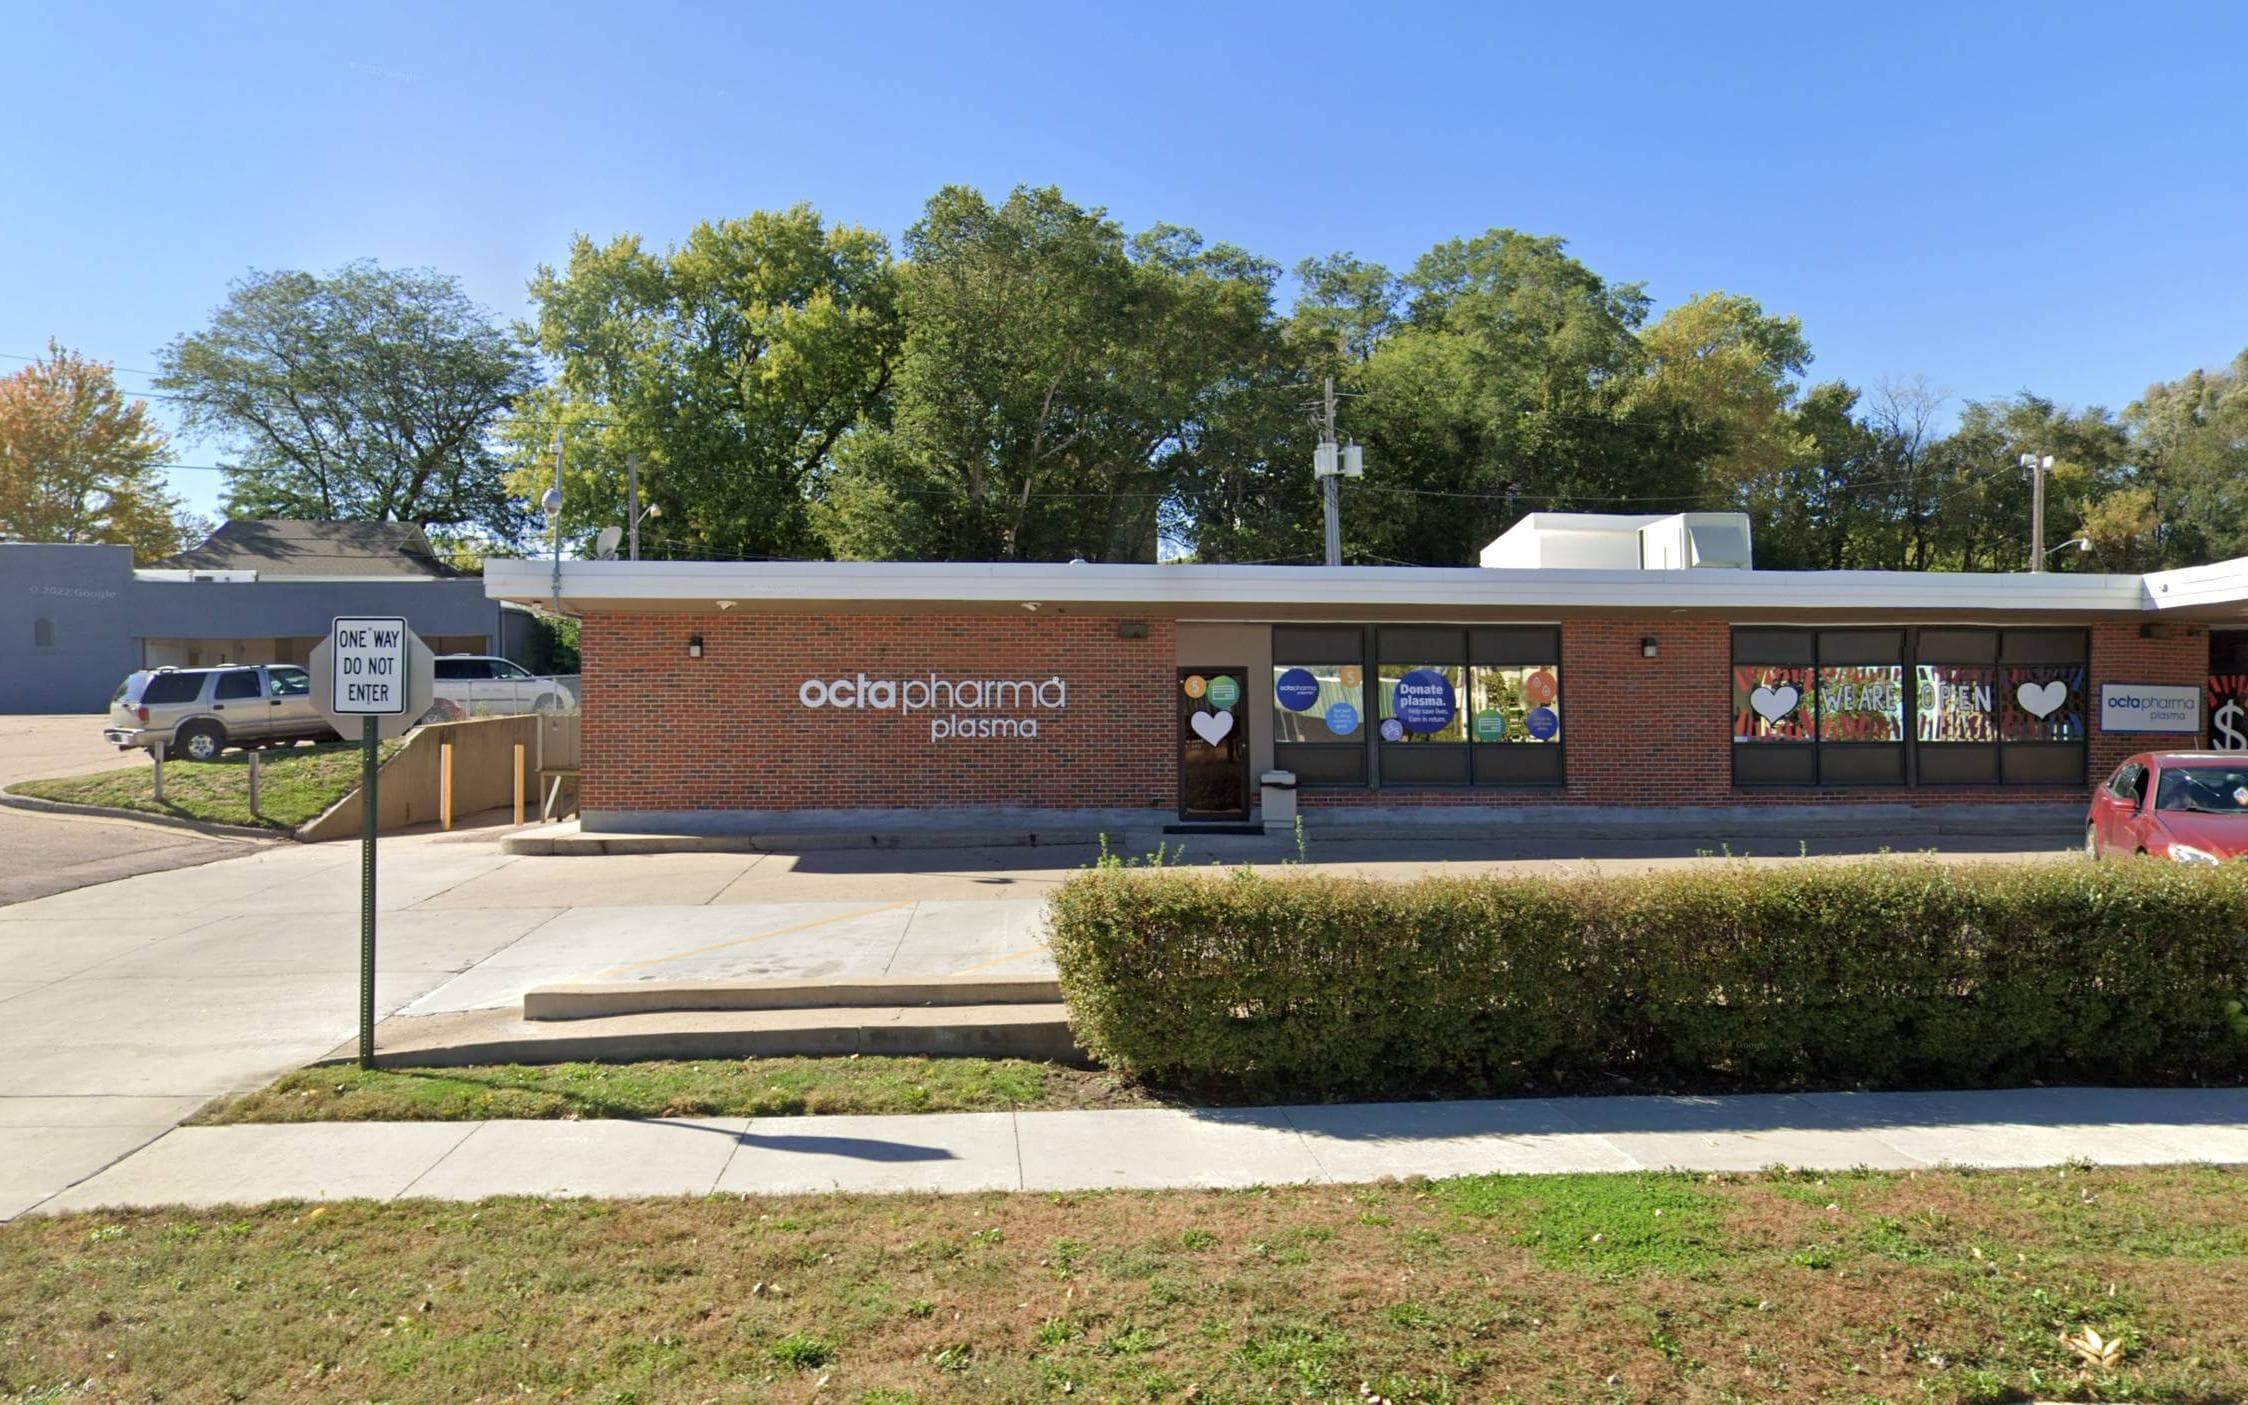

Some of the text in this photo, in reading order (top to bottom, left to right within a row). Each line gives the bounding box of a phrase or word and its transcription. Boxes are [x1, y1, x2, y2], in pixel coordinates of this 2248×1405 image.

[339, 630, 400, 648] ONE WAY
[343, 657, 394, 675] DO NOT
[348, 684, 389, 702] ENTER
[799, 673, 1066, 716] octapharma
[1400, 683, 1443, 694] Donate
[1821, 681, 1992, 713] WE ARE OPEN
[1400, 695, 1446, 708] plasma.
[2107, 695, 2195, 711] octapharma
[2149, 710, 2186, 721] plasma
[931, 713, 1037, 743] plasma
